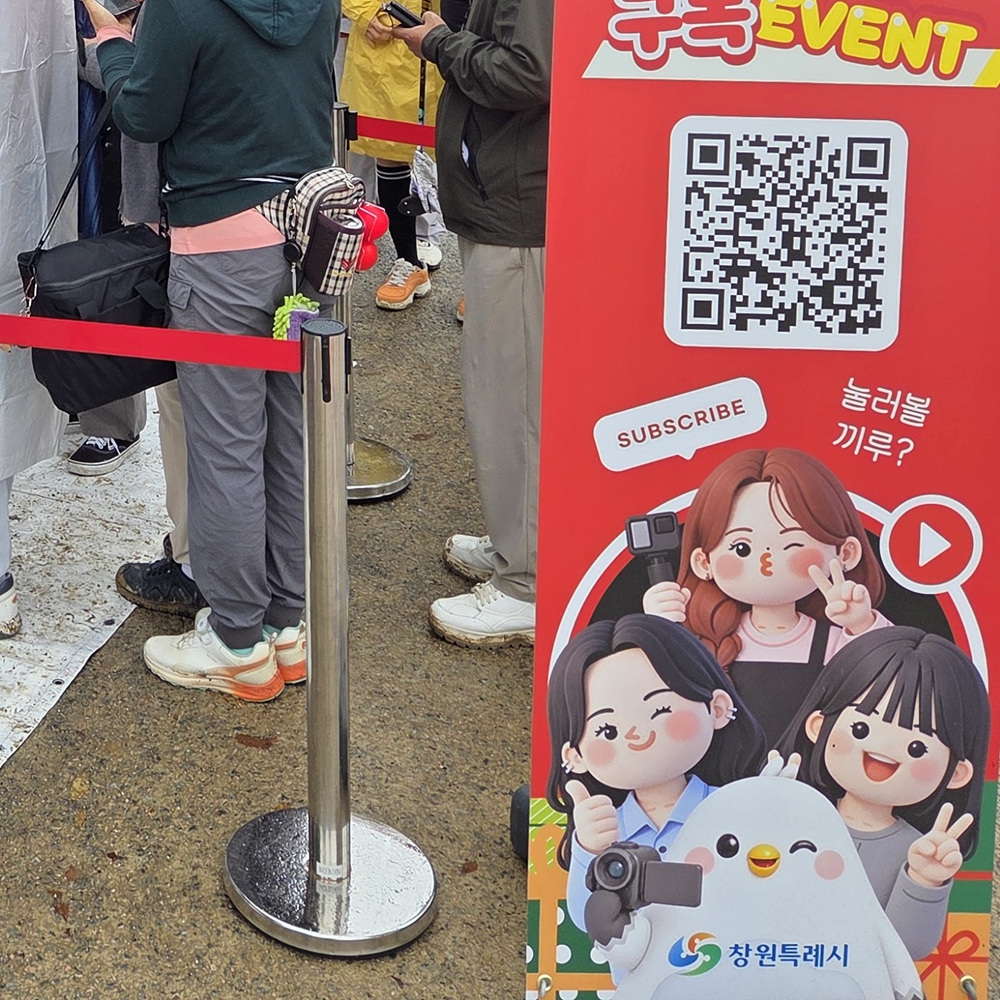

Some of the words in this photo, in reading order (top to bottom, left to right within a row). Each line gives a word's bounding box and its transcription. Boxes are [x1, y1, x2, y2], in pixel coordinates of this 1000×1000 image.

[617, 398, 746, 449] SUBSCRIBE
[841, 377, 931, 428] 눌러볼
[832, 422, 915, 468] 끼루?
[728, 943, 849, 968] 창원특례시
